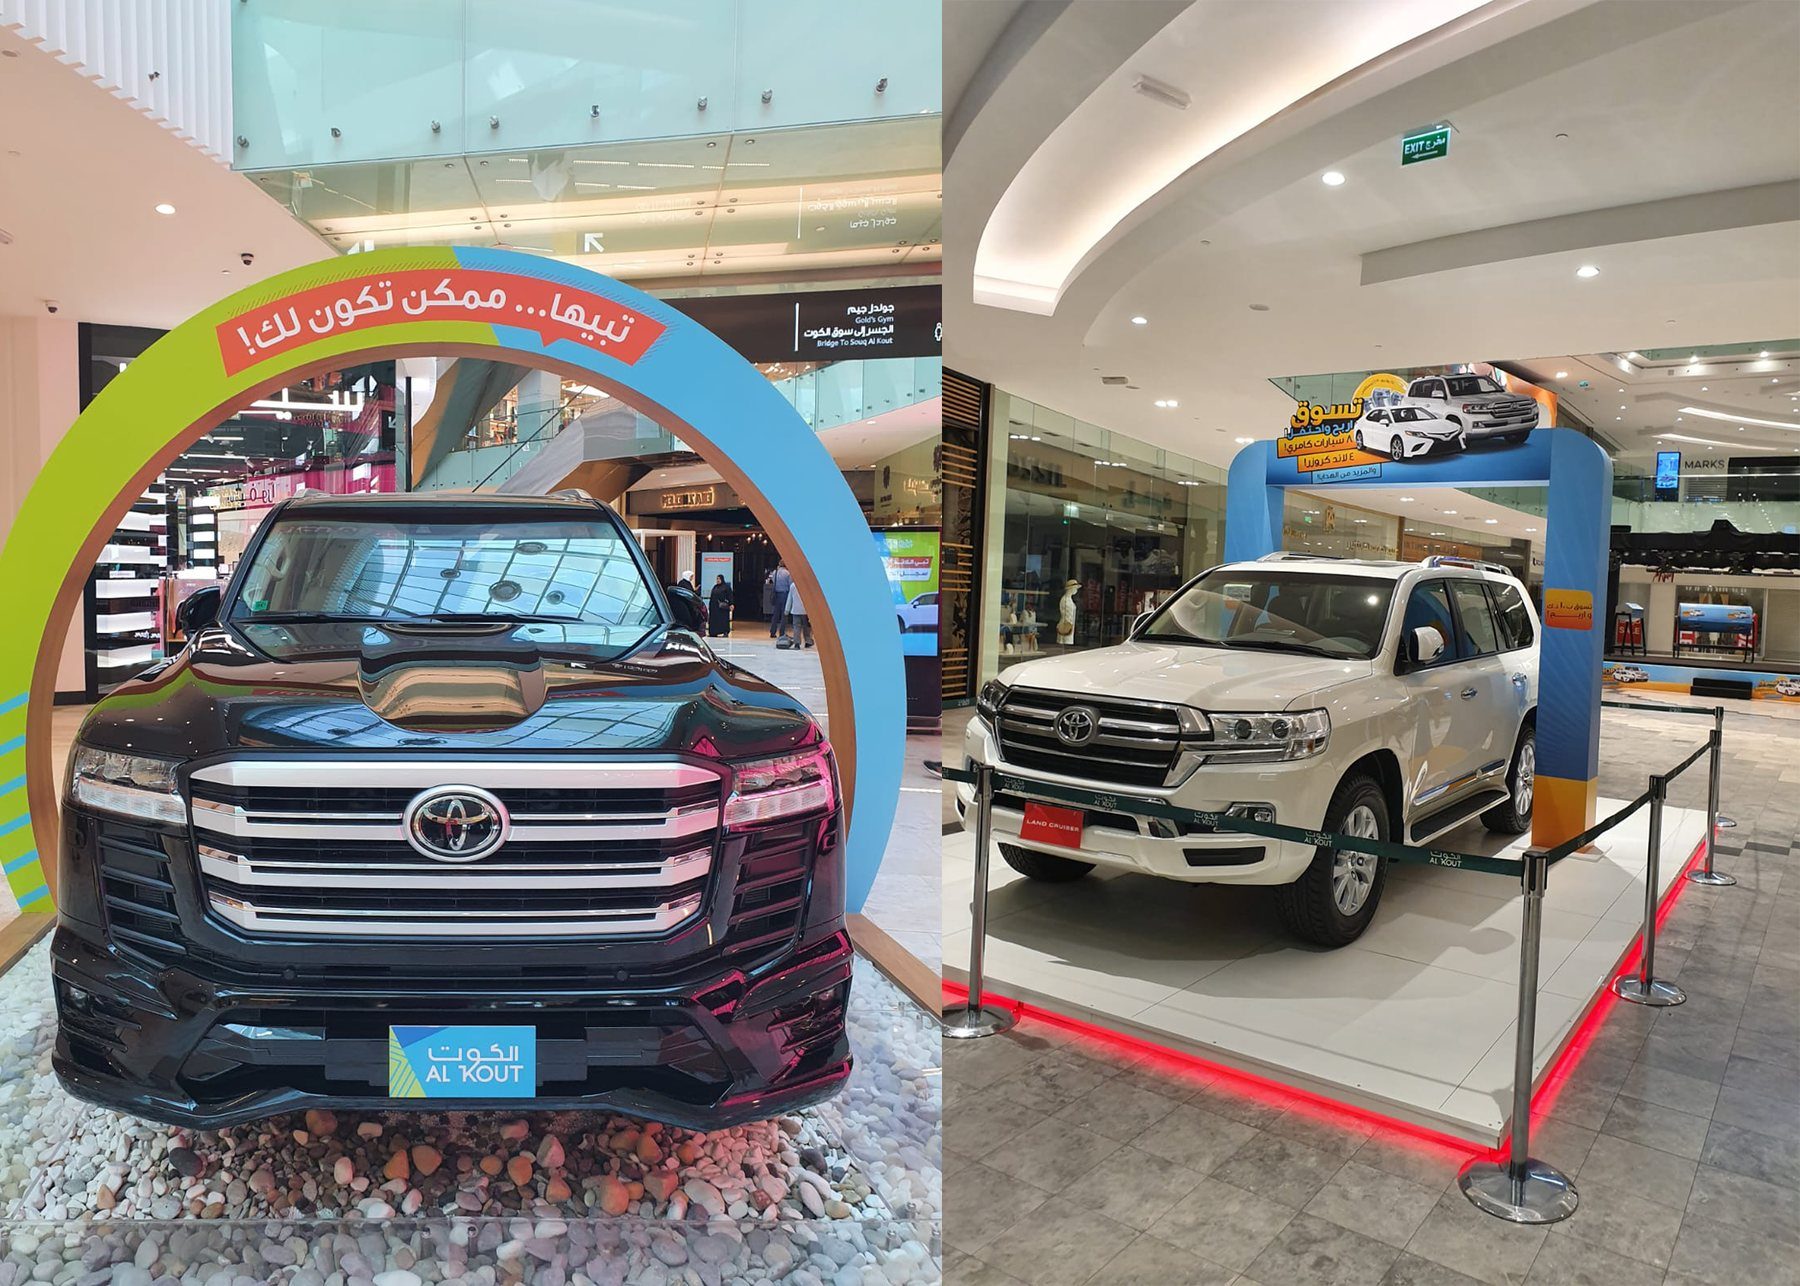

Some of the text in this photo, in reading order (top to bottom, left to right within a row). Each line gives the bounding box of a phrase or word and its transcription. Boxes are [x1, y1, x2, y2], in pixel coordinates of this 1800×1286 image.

[1404, 141, 1425, 155] EXIT
[1425, 135, 1446, 150] مخرج
[402, 277, 507, 314] ممكن
[308, 279, 395, 334] تكون
[847, 303, 895, 315] جولدز جيم
[877, 316, 894, 324] Gym
[236, 306, 302, 355] لك!
[803, 328, 831, 339] الكوت
[831, 327, 853, 338] سوق
[866, 325, 894, 336] الجسر
[817, 340, 839, 348] Bridge
[1291, 397, 1363, 428] تسوق
[1332, 420, 1353, 436] اربح
[1314, 437, 1344, 448] سيارات
[1333, 453, 1348, 463] لاند
[1684, 459, 1725, 470] MARKS
[1340, 471, 1351, 479] من
[1619, 627, 1640, 635] SLE
[1026, 819, 1080, 833] LAND CRUISER
[1440, 858, 1462, 868] KOUT
[427, 1043, 519, 1063] الكوت
[425, 1063, 524, 1083] AL KOUT
